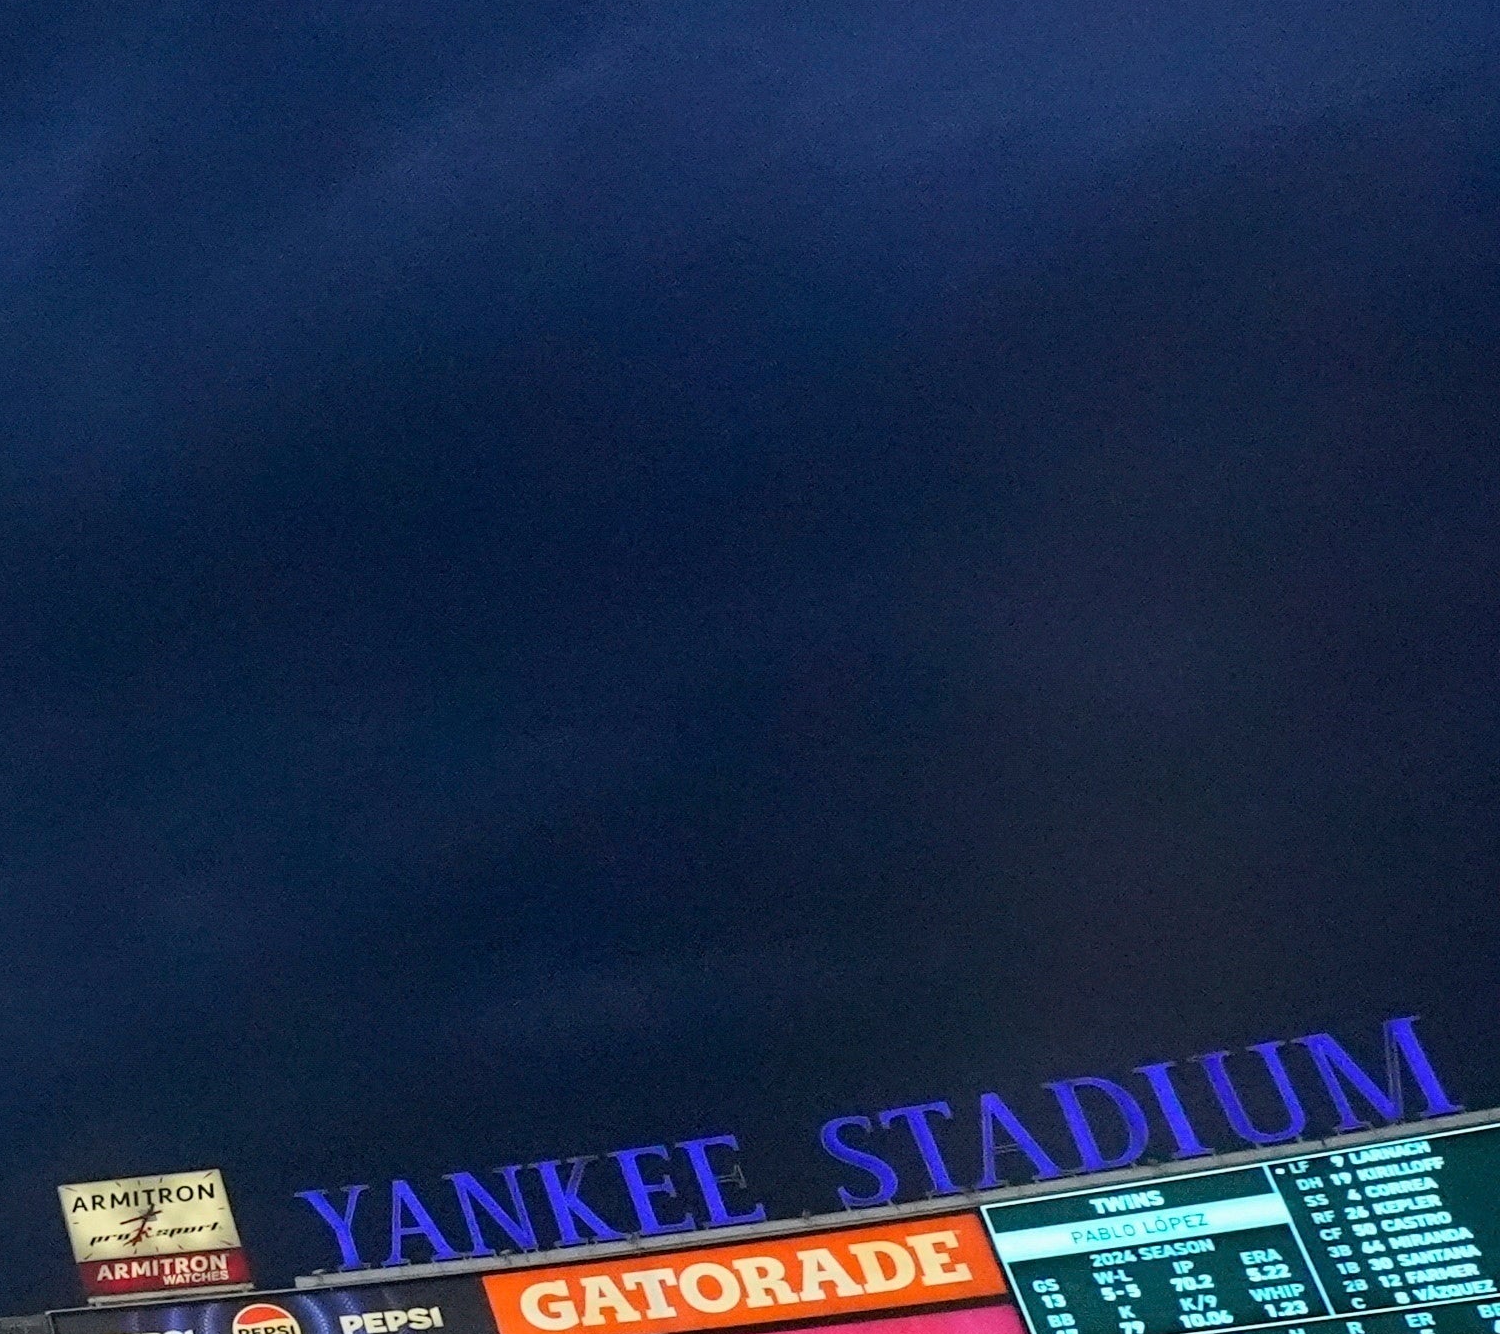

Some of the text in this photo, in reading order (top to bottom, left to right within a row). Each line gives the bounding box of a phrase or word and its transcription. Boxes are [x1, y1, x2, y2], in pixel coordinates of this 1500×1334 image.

[294, 1015, 1465, 1271] YANKEE STADIUM
[1288, 1140, 1431, 1174] LF 9 LARNACH
[1295, 1155, 1445, 1191] DH 19 KIRILLOFF
[72, 1182, 216, 1213] ARMITRON
[1089, 1189, 1165, 1215] TWINS
[1303, 1177, 1439, 1208] SS CORREA
[1311, 1193, 1443, 1225] RF 26 KEPLER
[1070, 1212, 1210, 1245] PABLO LÓPEZ
[1319, 1211, 1453, 1241] CF CASTRO
[1089, 1238, 1215, 1268] 2024 SEASON
[1327, 1226, 1475, 1259] 3B MIRANDA
[96, 1252, 228, 1282] ARMITRON
[1032, 1248, 1283, 1294] GS W-L IP ERA
[1336, 1244, 1483, 1275] 1B 30 SANTANA
[163, 1269, 230, 1286] WATCHES
[520, 1228, 973, 1332] GATORADE
[1040, 1293, 1067, 1309] 13
[1169, 1274, 1214, 1293] 70.2
[1245, 1264, 1292, 1283] 5.22
[1342, 1263, 1481, 1293] 2B 12 FARMER
[1046, 1283, 1305, 1329] BB K K/9 WHIP
[1179, 1309, 1234, 1329] 10.06
[1264, 1300, 1309, 1319] 1.23
[1351, 1297, 1367, 1310] C
[1404, 1311, 1437, 1328] ER
